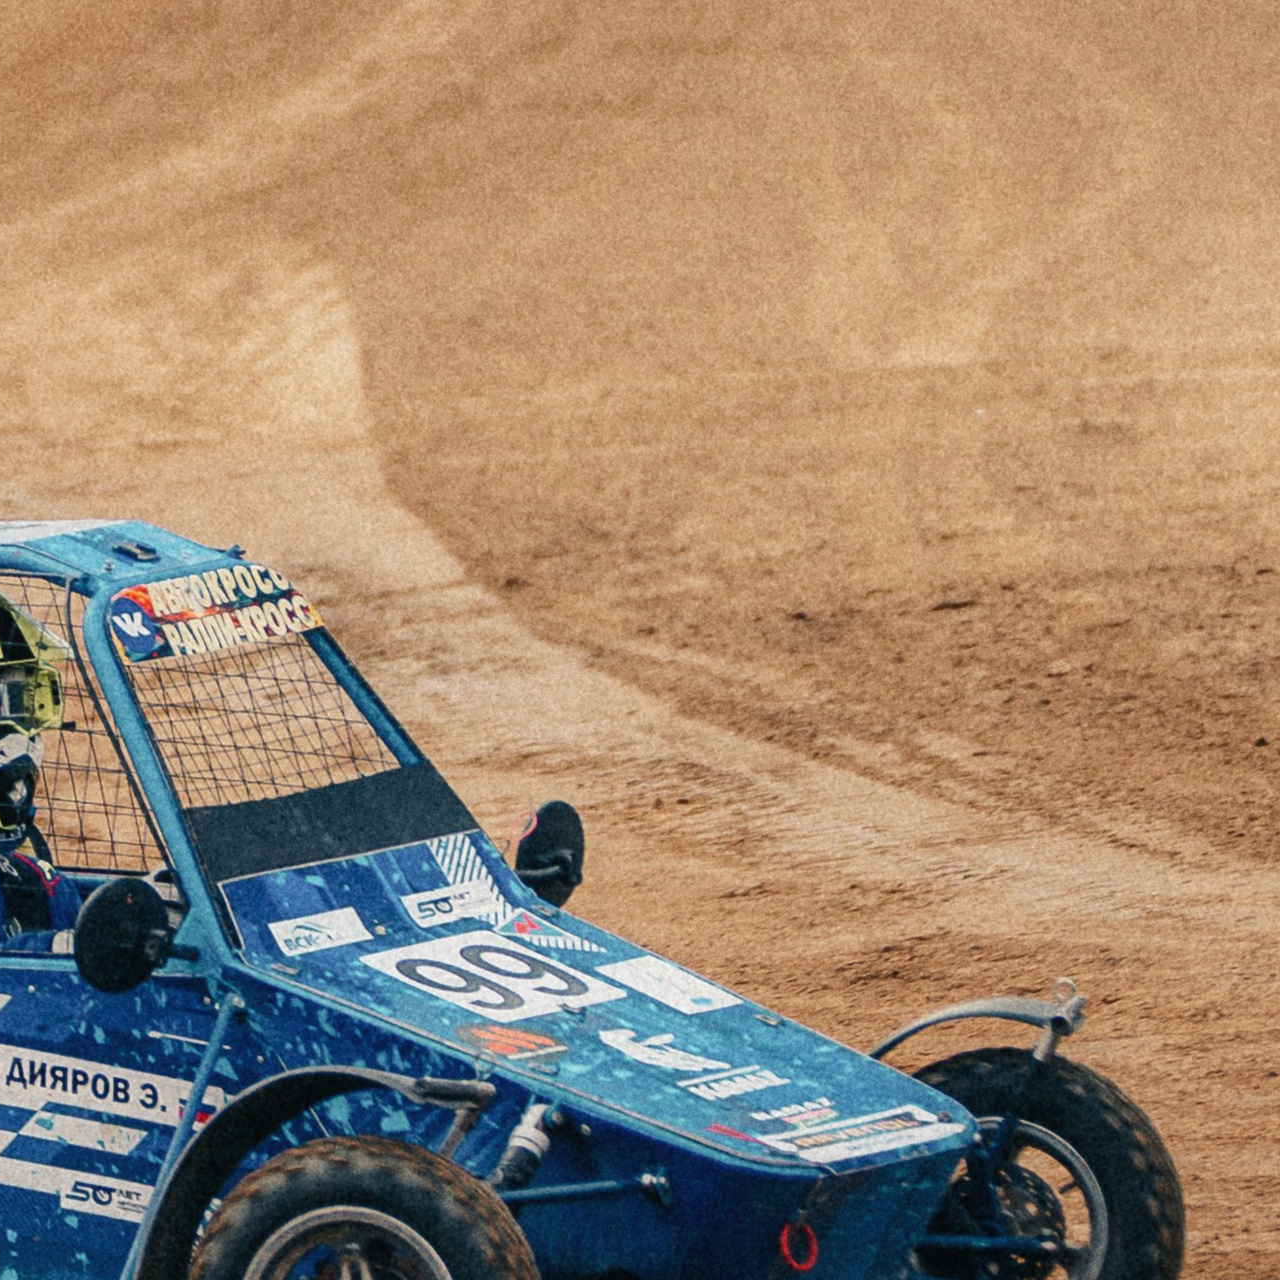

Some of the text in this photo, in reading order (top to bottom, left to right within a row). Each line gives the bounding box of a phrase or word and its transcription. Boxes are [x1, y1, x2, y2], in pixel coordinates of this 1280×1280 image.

[161, 595, 318, 657] РАЛЛИ-КРОСС
[396, 944, 589, 1011] 99
[6, 1056, 168, 1113] ДИЯРОВ Э.
[65, 1180, 117, 1206] 50
